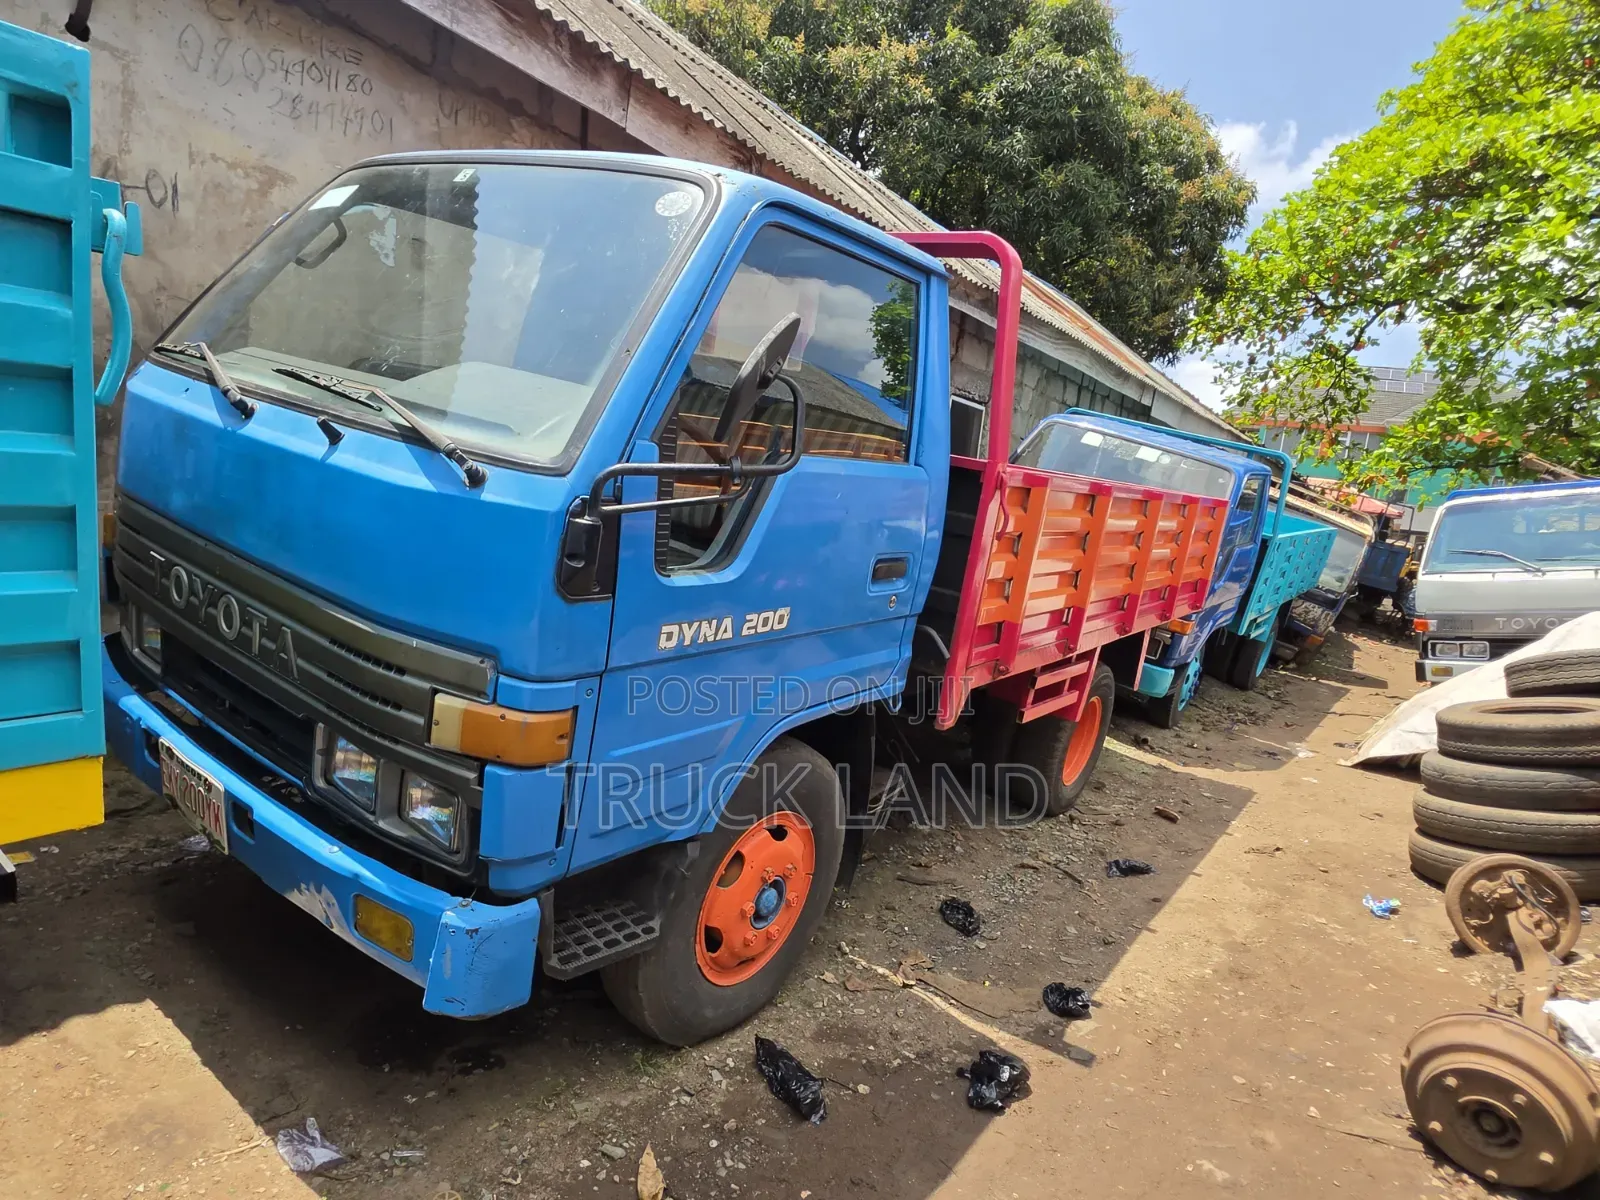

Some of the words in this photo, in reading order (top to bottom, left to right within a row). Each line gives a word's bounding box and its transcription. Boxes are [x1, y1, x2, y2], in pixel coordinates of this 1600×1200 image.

[150, 550, 300, 682] TOYOTA
[657, 613, 734, 651] DYNA
[740, 606, 791, 637] 200
